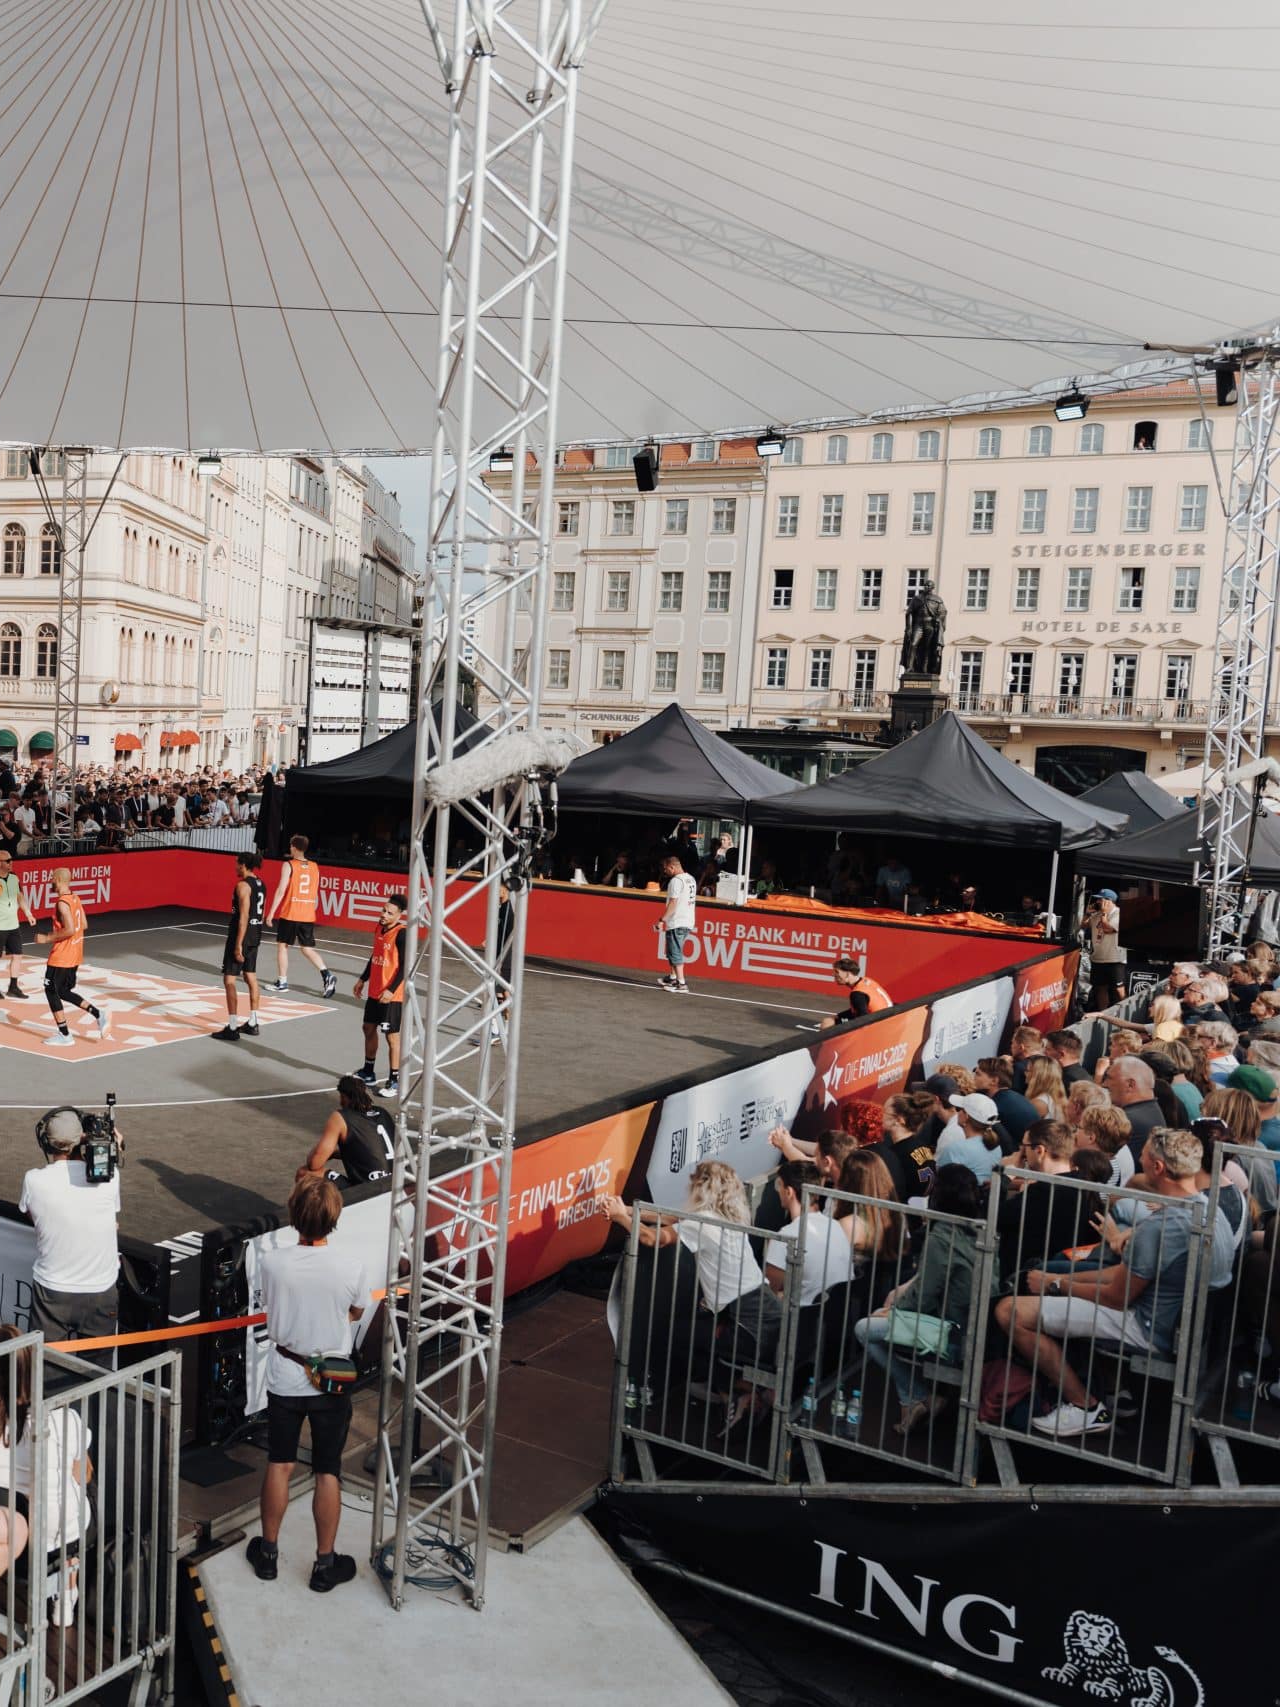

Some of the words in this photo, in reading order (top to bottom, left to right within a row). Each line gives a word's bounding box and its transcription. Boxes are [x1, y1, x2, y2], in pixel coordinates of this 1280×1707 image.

[1011, 543, 1206, 558] STEIGENBERGER
[1022, 621, 1087, 633] HOTEL
[1096, 622, 1120, 633] DE
[1130, 622, 1183, 634] SAXE
[22, 871, 39, 884] DIE
[72, 867, 89, 880] MIT
[91, 865, 111, 878] DEM
[300, 874, 311, 895] 2
[320, 876, 340, 891] DIE
[343, 879, 381, 895] BANK
[384, 883, 408, 896] MIT
[256, 892, 265, 915] 2
[703, 920, 730, 937] DIE
[735, 924, 785, 943] BANK
[790, 931, 823, 948] MIT
[828, 935, 867, 953] DEM
[844, 1060, 858, 1084] DIE
[858, 1048, 890, 1078] FINALS
[376, 1125, 395, 1160] 1
[518, 1171, 576, 1220] FINALS
[575, 1159, 612, 1197] 2025
[810, 1540, 1024, 1664] ING
